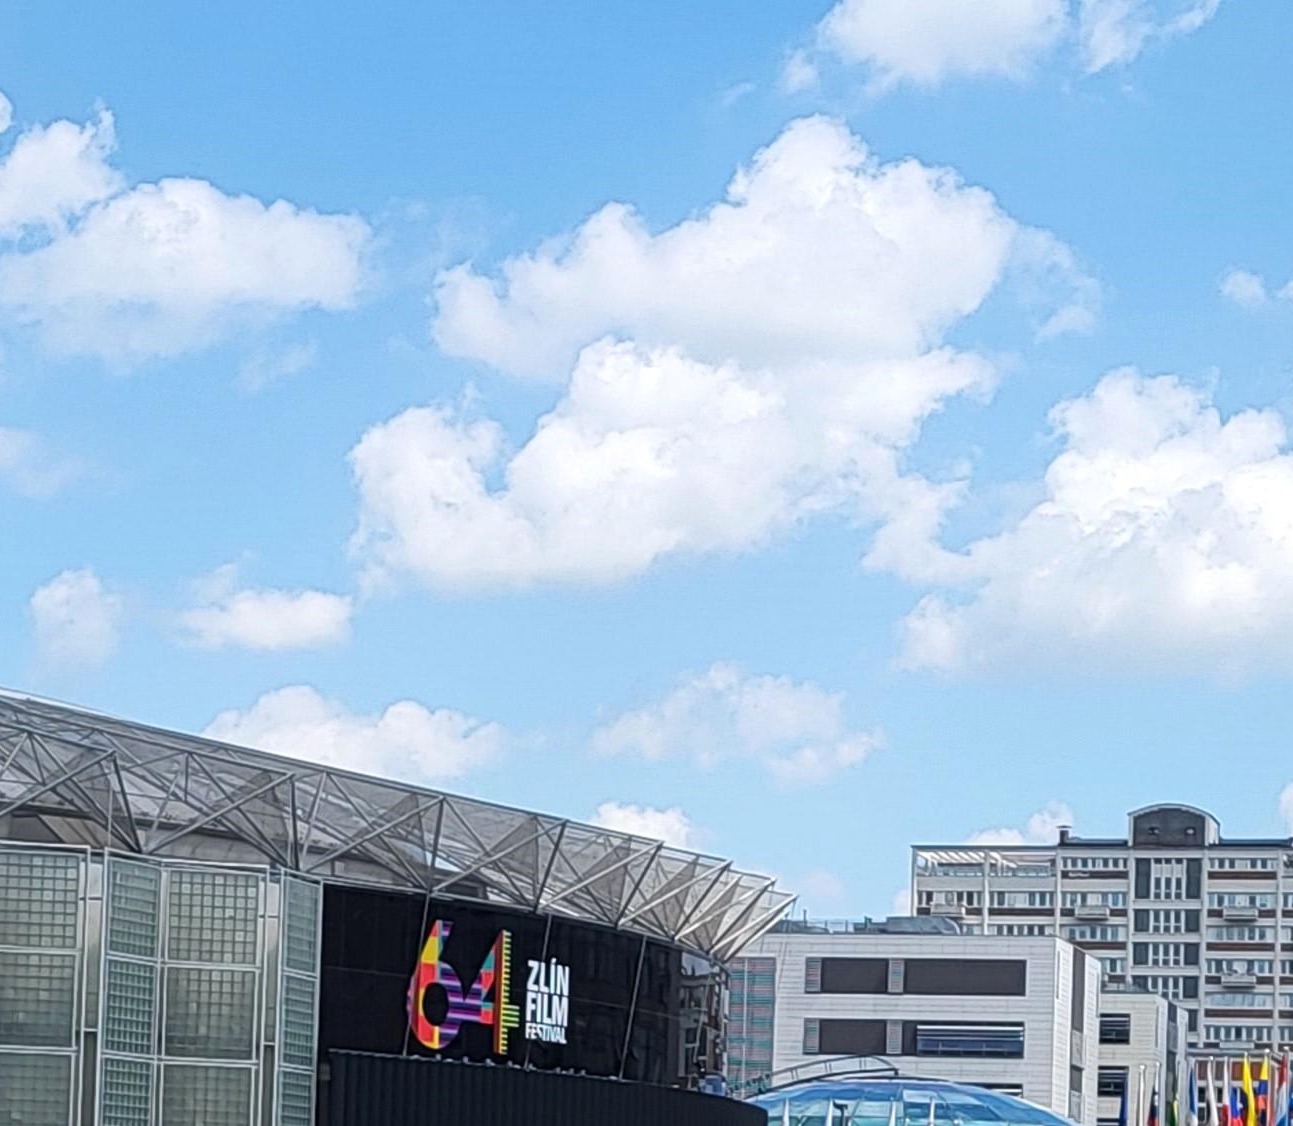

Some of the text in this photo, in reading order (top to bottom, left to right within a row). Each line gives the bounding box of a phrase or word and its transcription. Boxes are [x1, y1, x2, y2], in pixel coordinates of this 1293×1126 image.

[406, 919, 520, 1055] 64
[526, 957, 570, 996] ZLÍN
[525, 991, 569, 1027] FILM
[525, 1022, 568, 1044] FESTIVAL
